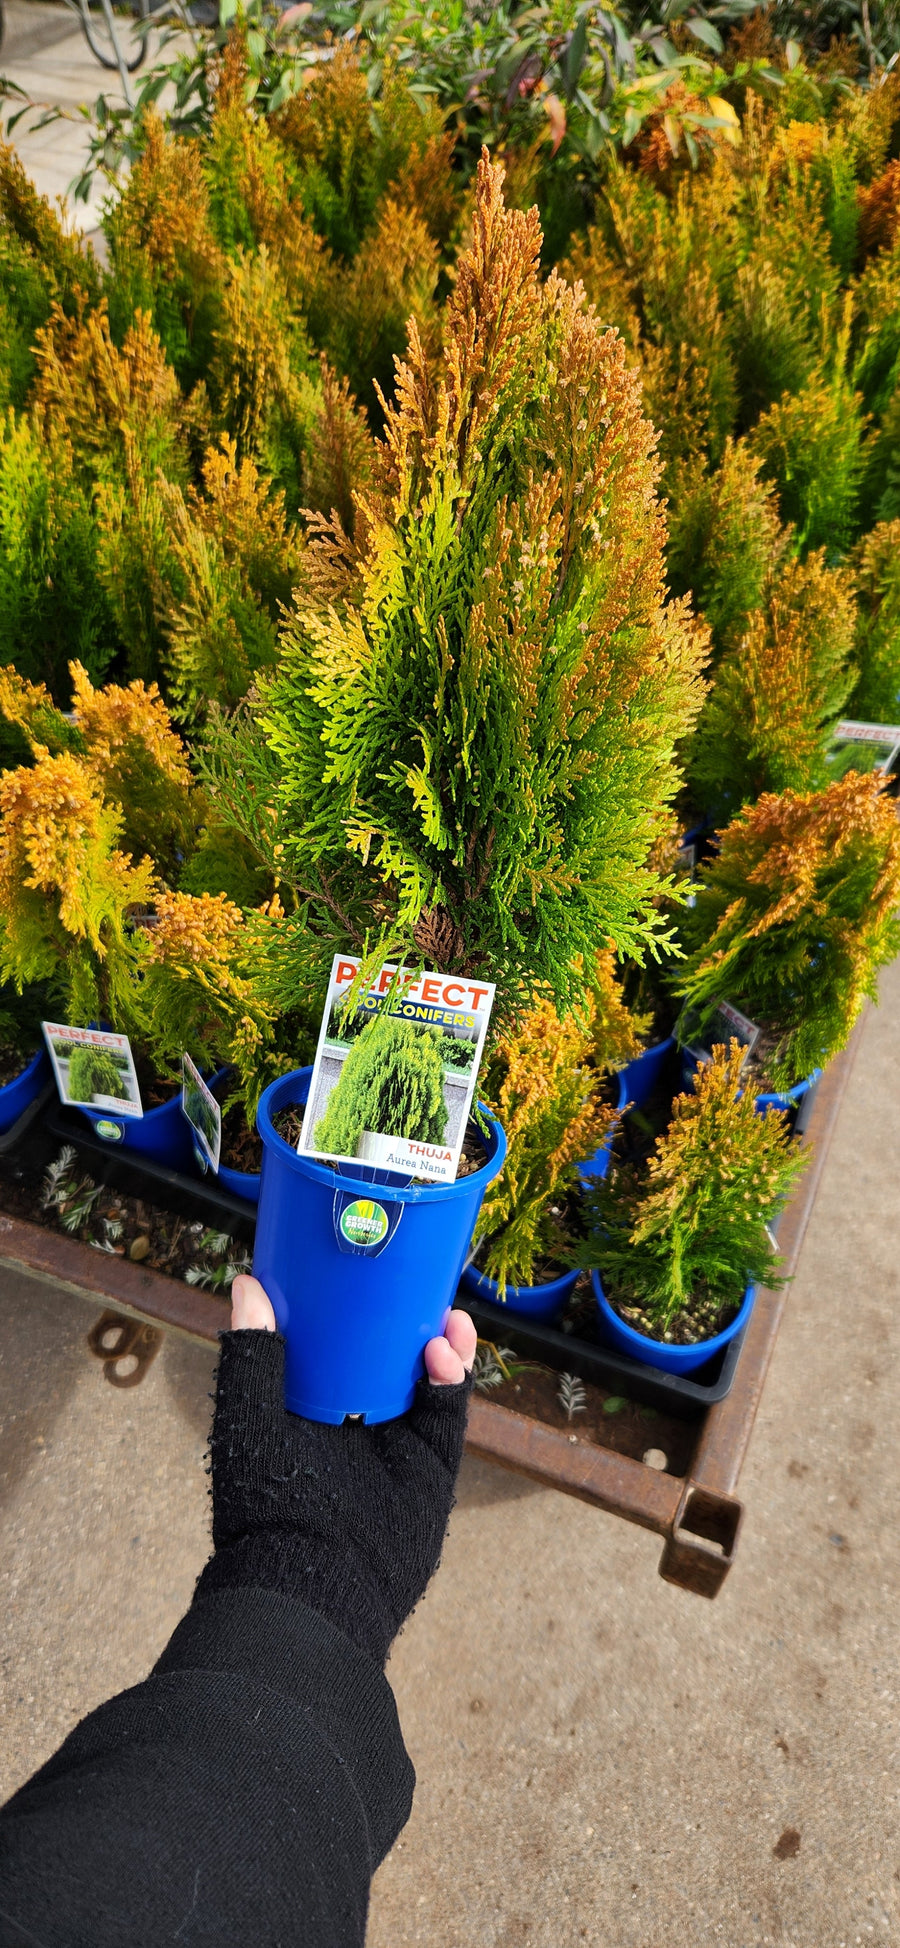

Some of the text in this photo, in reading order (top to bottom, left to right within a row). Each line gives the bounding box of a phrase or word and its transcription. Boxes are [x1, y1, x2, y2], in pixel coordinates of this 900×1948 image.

[335, 961, 489, 1011] PRFECT
[47, 1025, 125, 1047] PERFECT
[408, 1143, 452, 1162] THUJA
[386, 1153, 447, 1175] Aurea Nana
[345, 1220, 382, 1234] GROWTH
